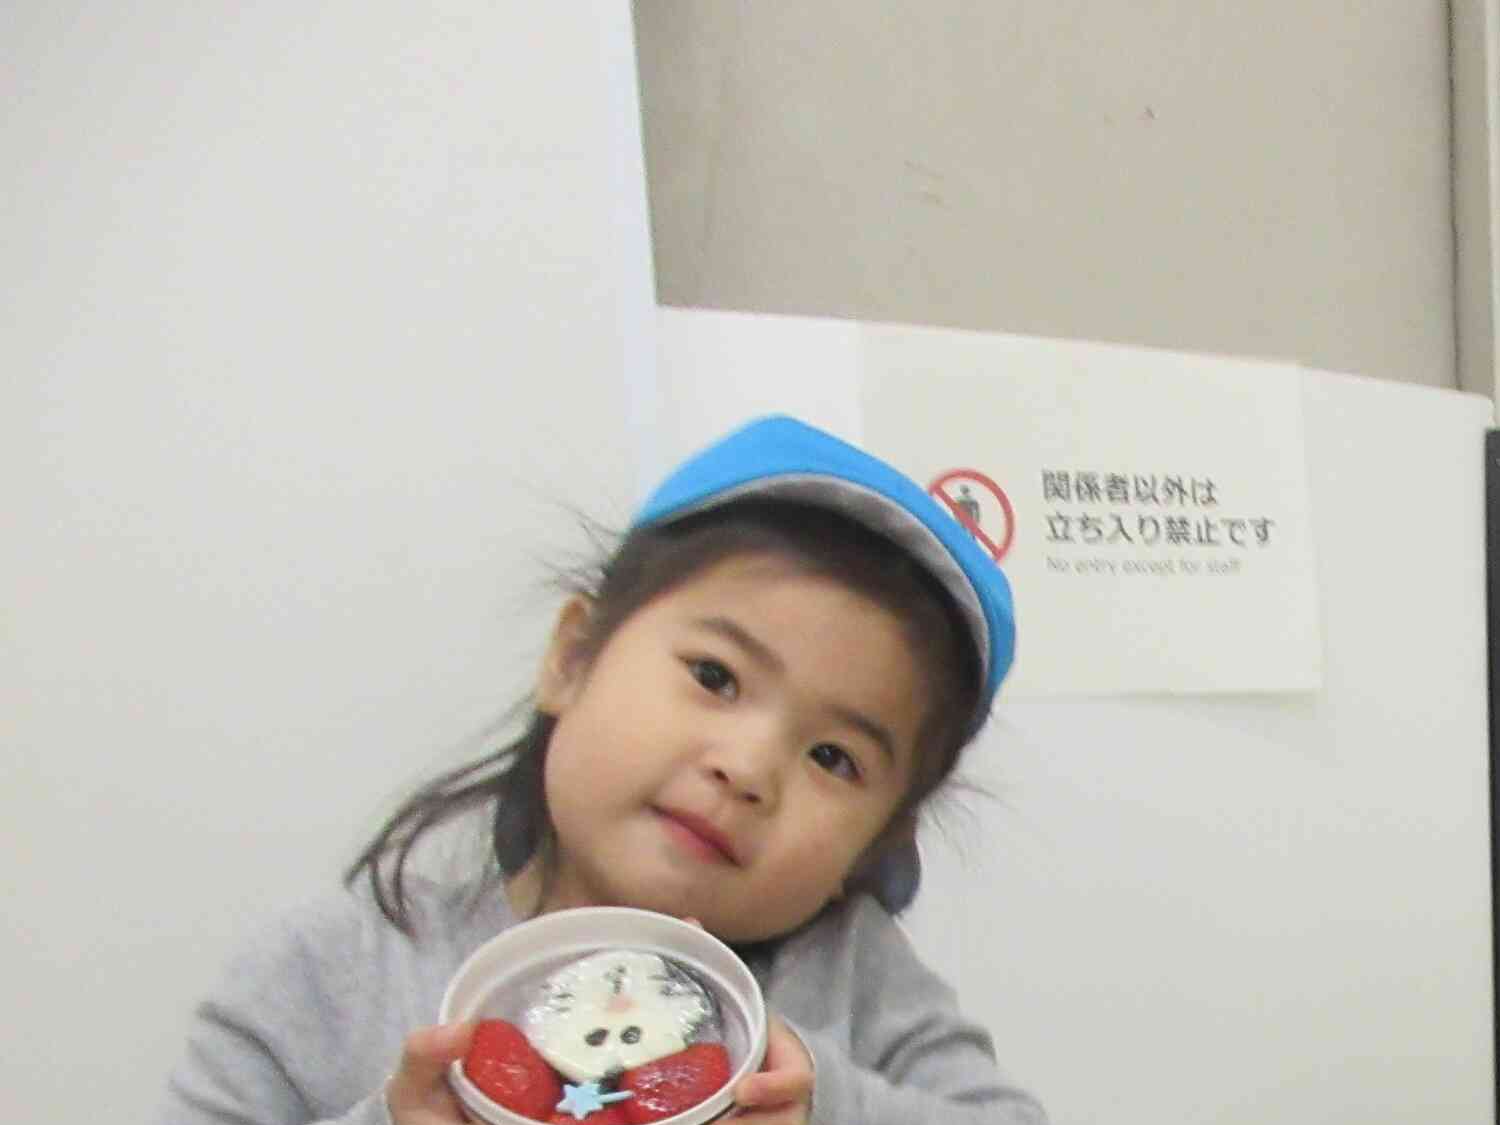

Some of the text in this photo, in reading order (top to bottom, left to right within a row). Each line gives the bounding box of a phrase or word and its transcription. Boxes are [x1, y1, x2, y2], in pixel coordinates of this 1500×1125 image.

[1042, 469, 1217, 505] 関係者以外は
[1045, 511, 1275, 547] 立ち入り禁止です
